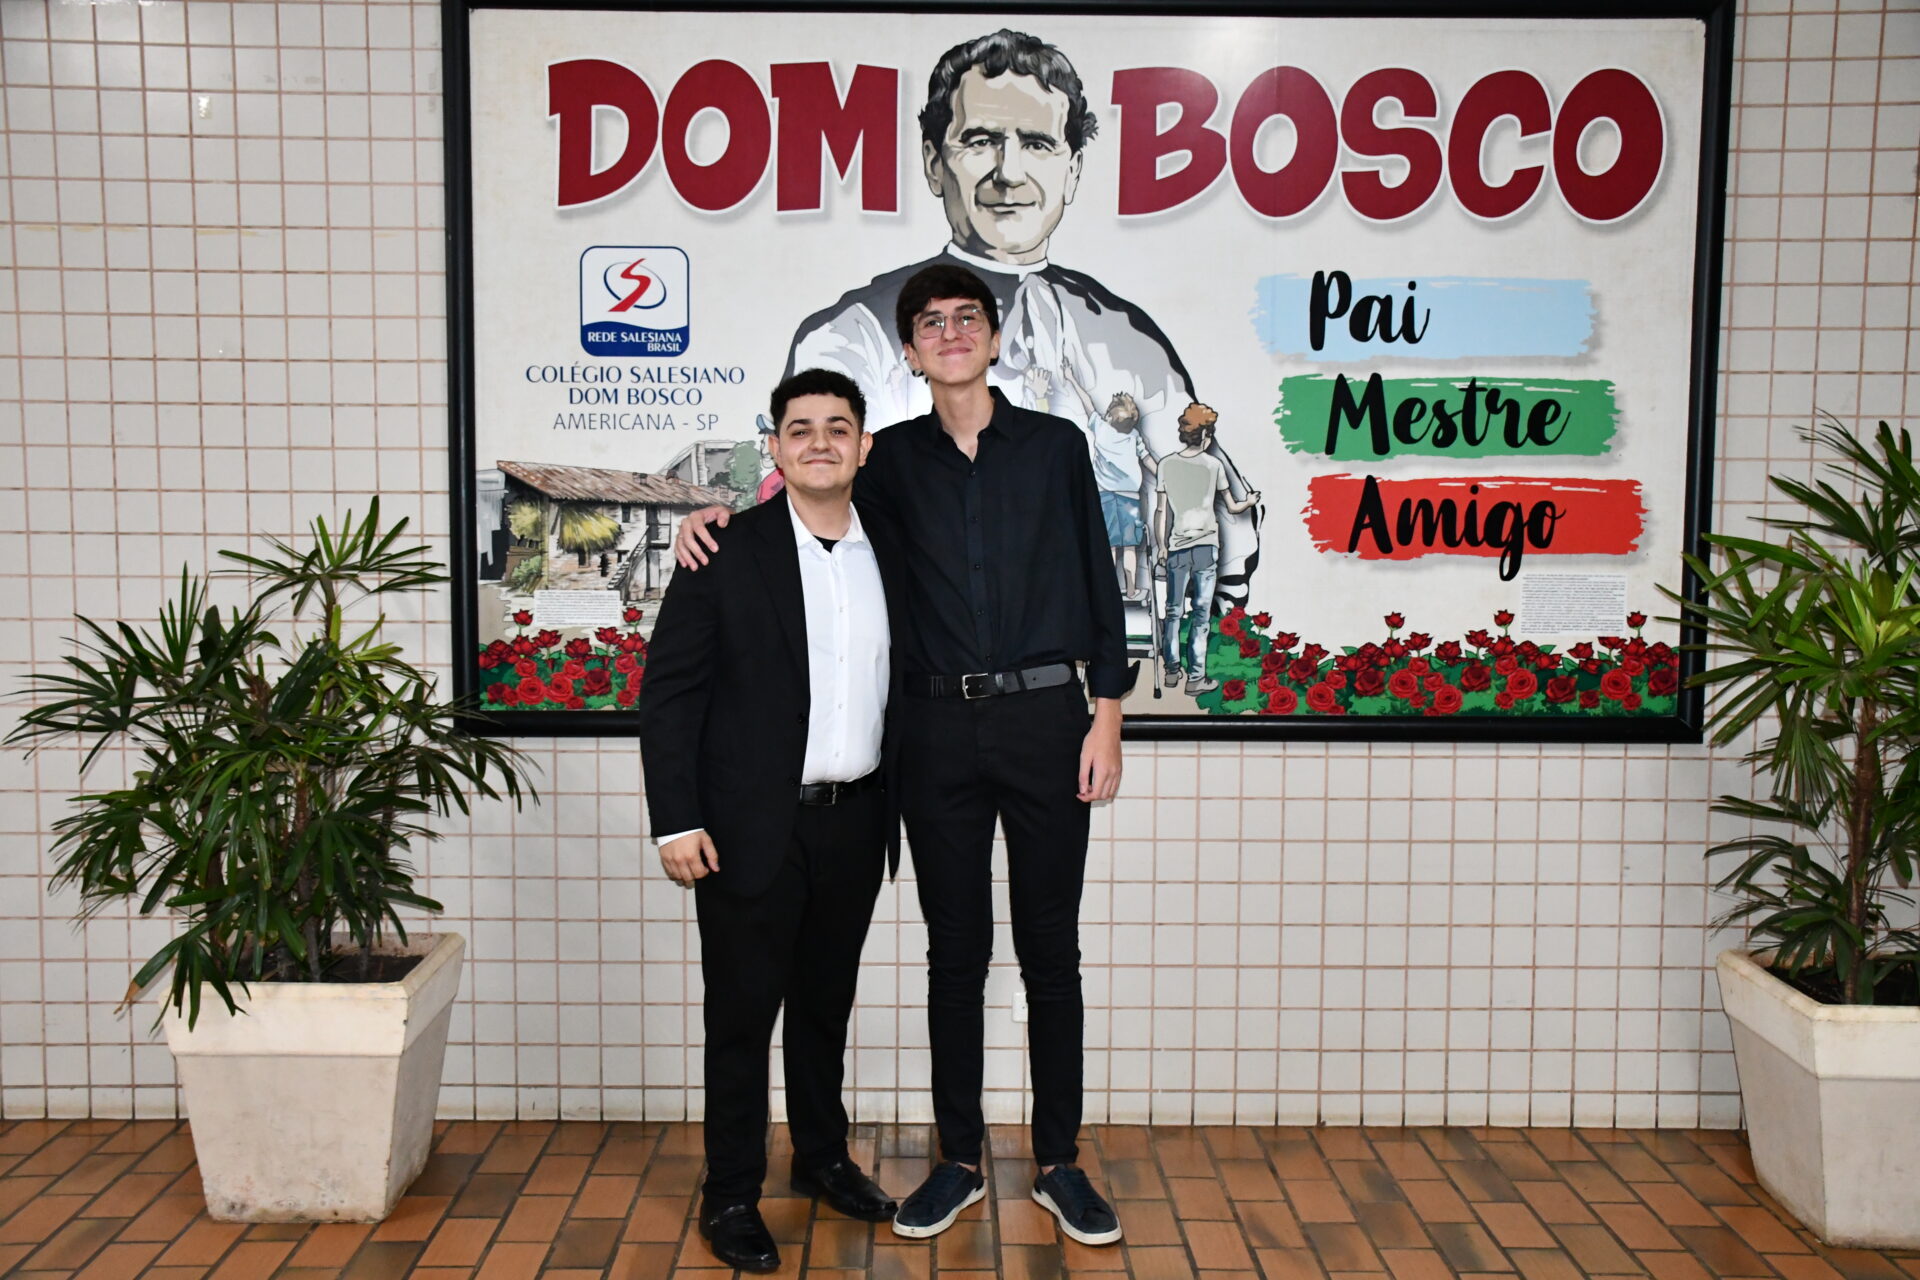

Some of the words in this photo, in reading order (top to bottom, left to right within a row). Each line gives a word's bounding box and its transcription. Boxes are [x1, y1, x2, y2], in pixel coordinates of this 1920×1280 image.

[548, 58, 899, 213] DOM
[1111, 67, 1663, 221] BOSCO
[1309, 270, 1430, 352] Pai
[588, 332, 617, 343] REDE
[621, 332, 683, 343] SALESIANA
[647, 343, 682, 352] BRASIL
[525, 361, 623, 384] COLÉGIO
[629, 365, 745, 385] SALESIANO
[568, 387, 619, 406] DOM
[627, 387, 703, 406] BOSCO
[553, 412, 676, 431] AMERICANA
[696, 413, 719, 431] SP
[1325, 372, 1571, 456] Mestre
[1348, 474, 1567, 582] Amigo
